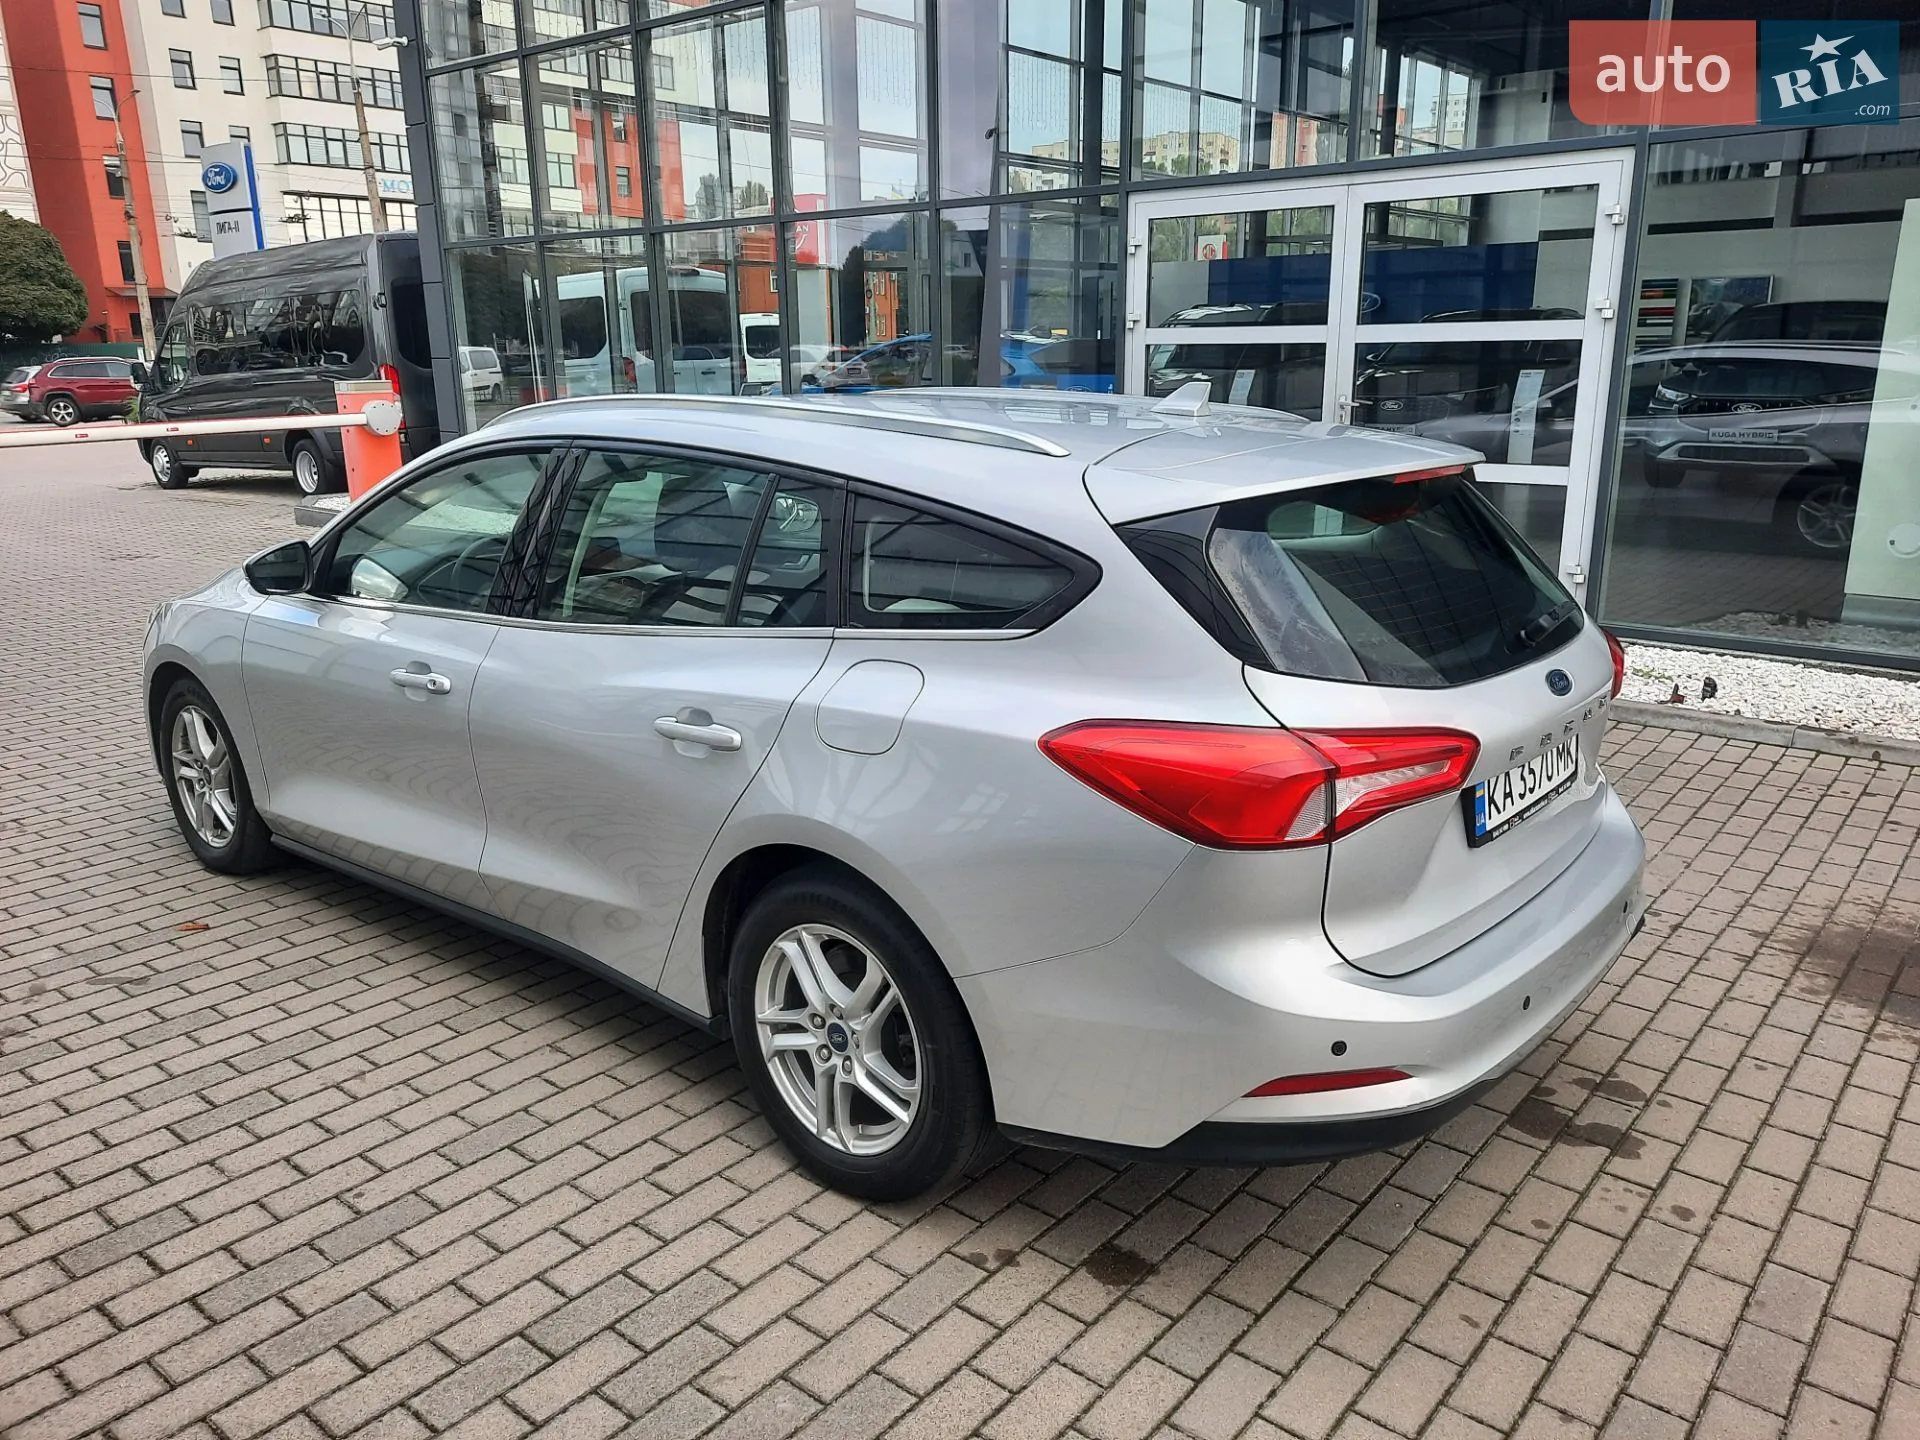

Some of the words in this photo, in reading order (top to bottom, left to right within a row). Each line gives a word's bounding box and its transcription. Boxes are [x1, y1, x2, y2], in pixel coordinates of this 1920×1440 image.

[206, 167, 227, 186] Ford
[1738, 431, 1774, 439] HYBRID
[1487, 770, 1515, 821] KA
[1556, 738, 1574, 777] MK
[1475, 811, 1486, 827] UA
